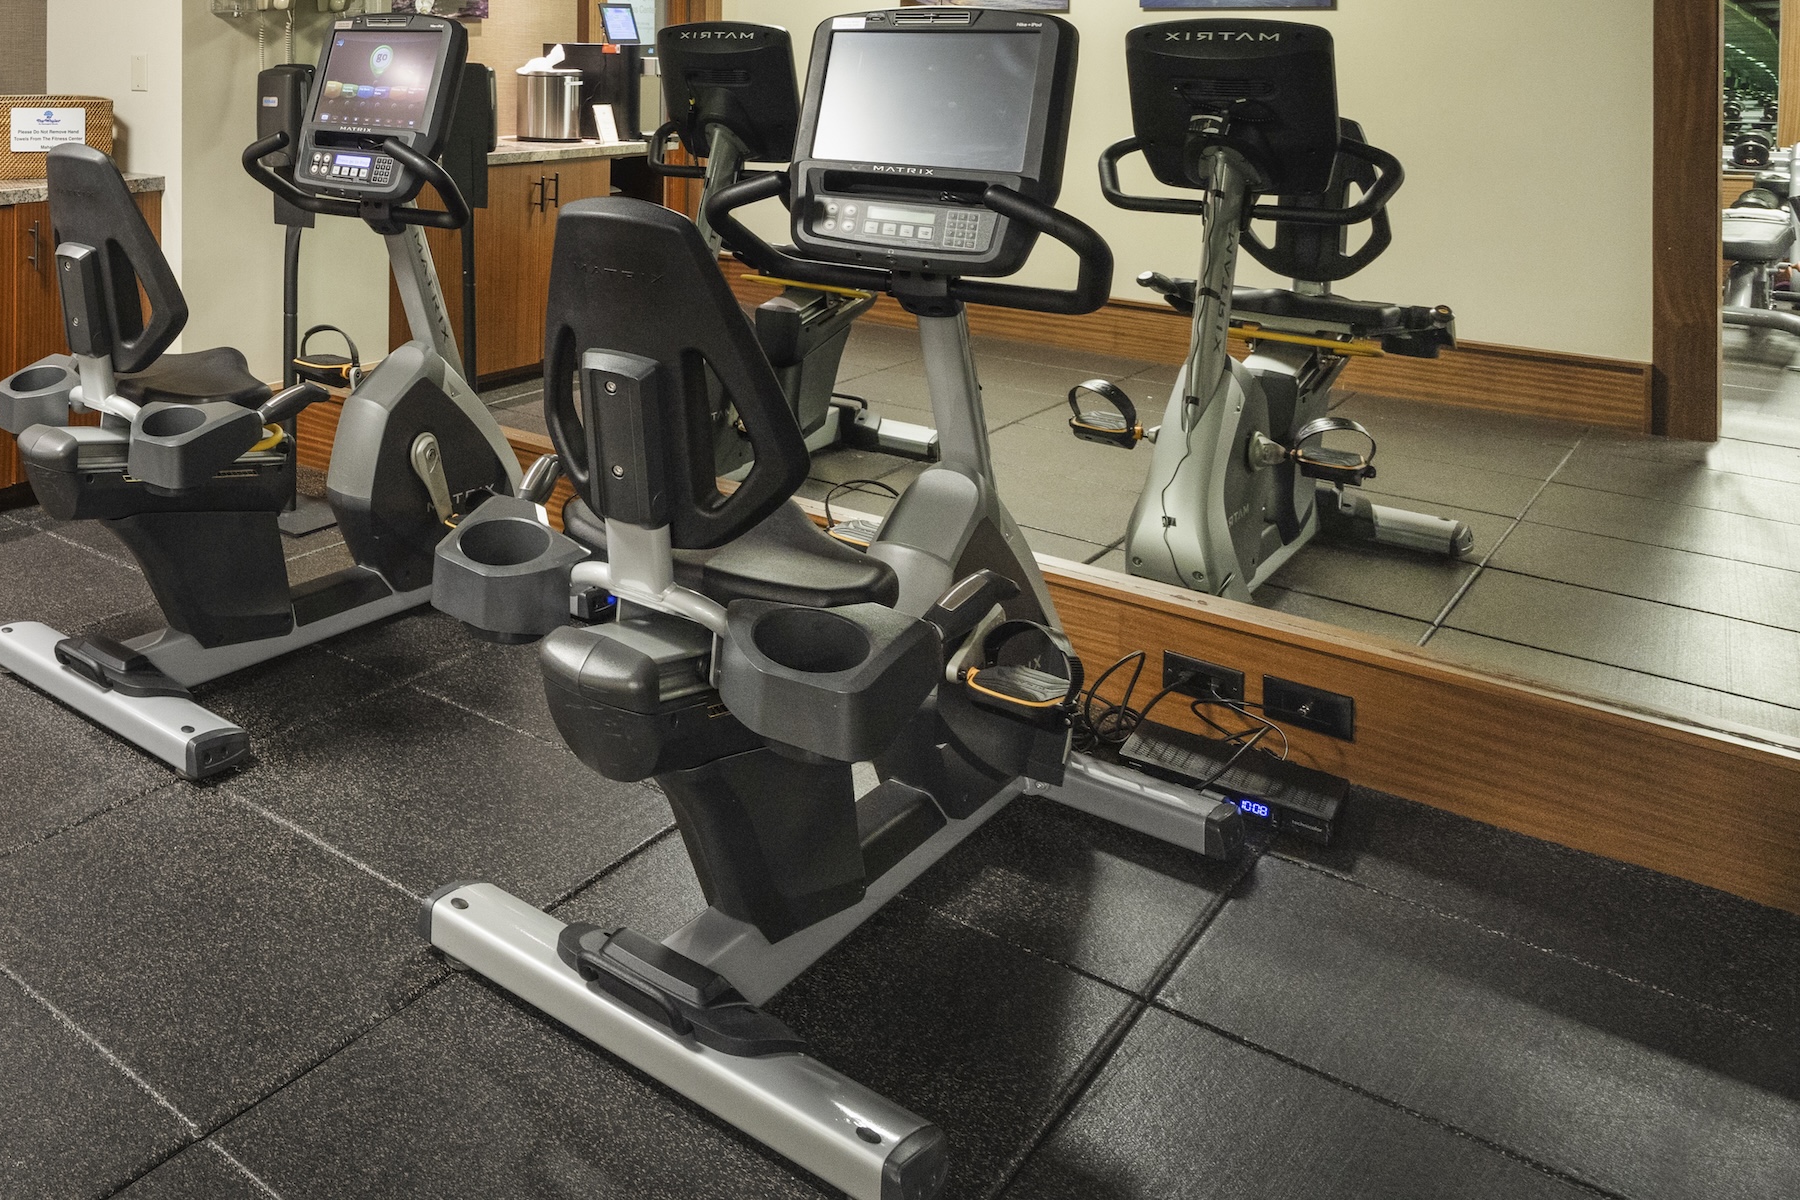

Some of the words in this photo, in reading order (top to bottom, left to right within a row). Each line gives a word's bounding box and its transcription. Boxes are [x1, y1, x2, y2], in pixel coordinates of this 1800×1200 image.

[375, 54, 388, 63] go
[872, 165, 934, 176] MATRIX
[1241, 799, 1269, 817] 10:08
